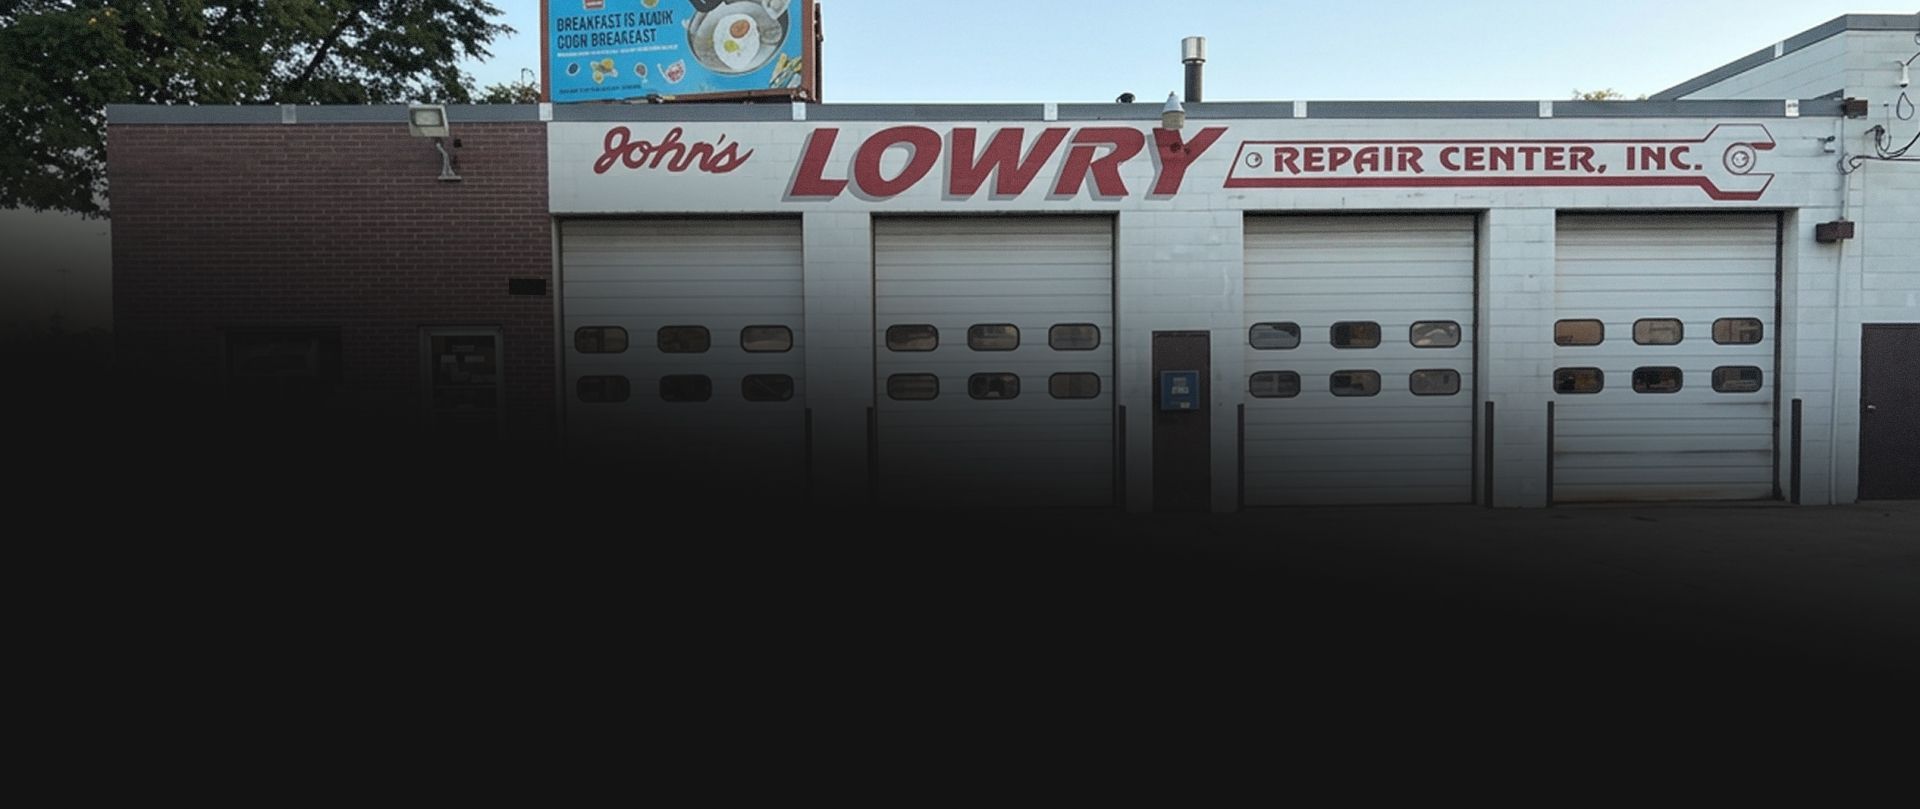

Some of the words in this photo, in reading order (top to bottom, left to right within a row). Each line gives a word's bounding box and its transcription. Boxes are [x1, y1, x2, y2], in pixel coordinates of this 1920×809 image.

[624, 12, 636, 28] IS
[593, 126, 754, 175] John's
[787, 126, 1229, 200] LOWRY
[1273, 146, 1425, 174] REPAIR
[1438, 146, 1608, 175] CENTER,
[1625, 145, 1703, 171] INC.
